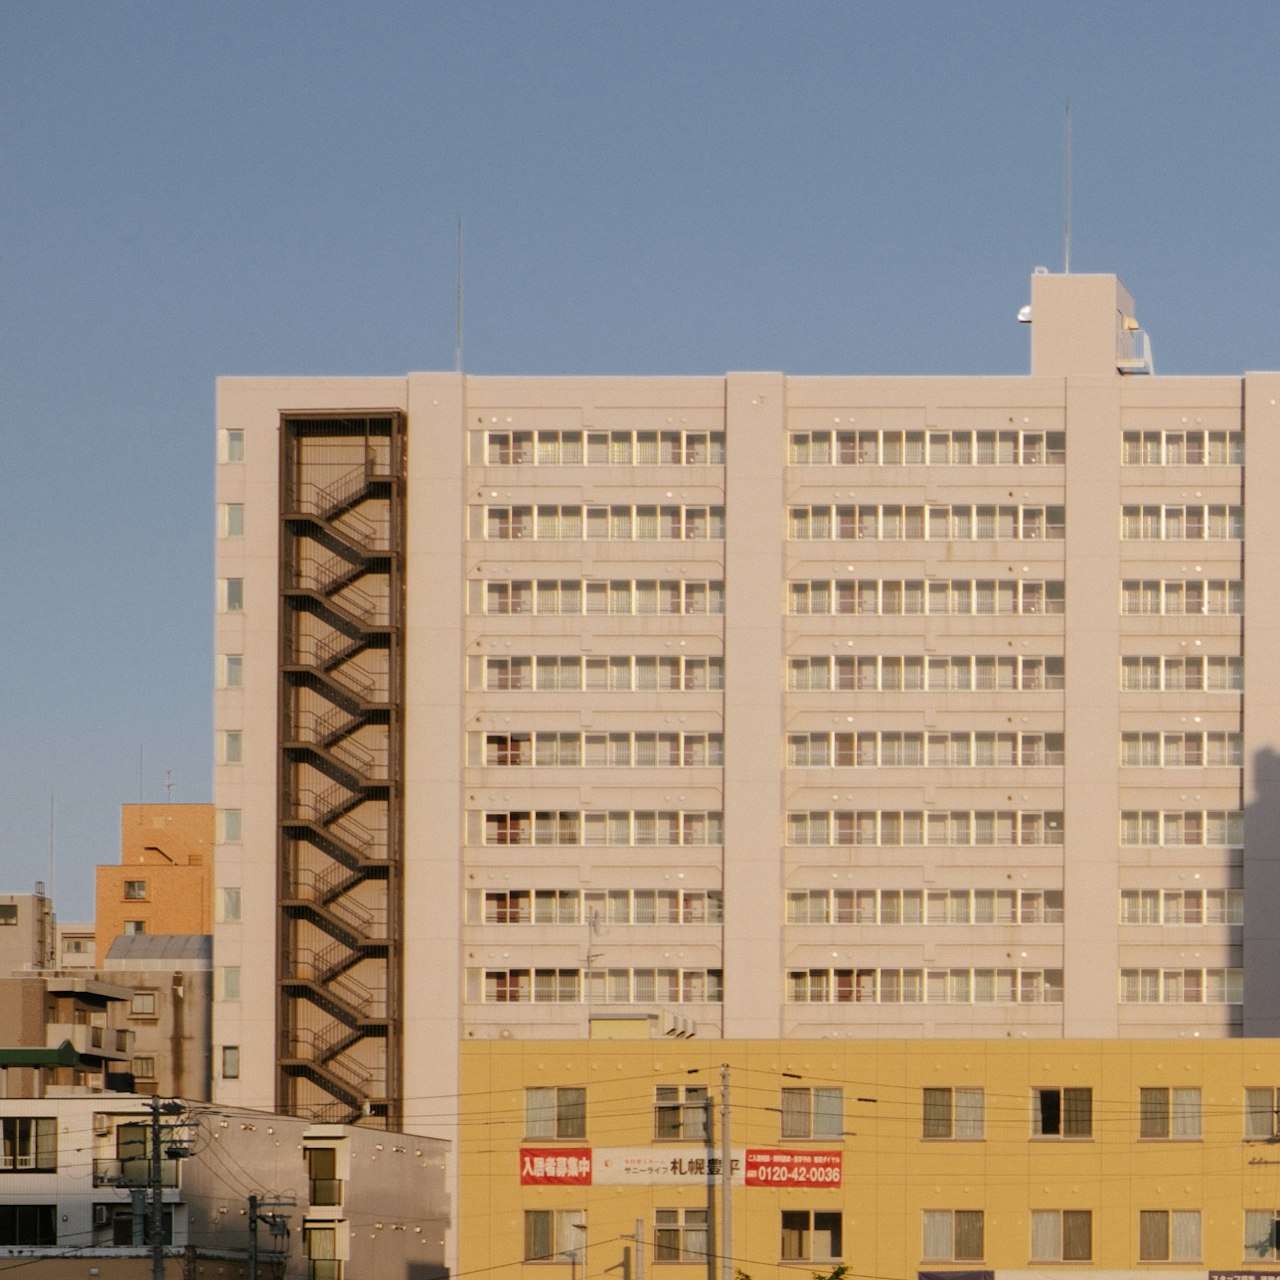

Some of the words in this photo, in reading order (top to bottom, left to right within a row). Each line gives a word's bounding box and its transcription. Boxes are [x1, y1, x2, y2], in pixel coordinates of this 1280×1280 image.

[522, 1156, 591, 1177] 入居者募集中
[758, 1166, 841, 1182] 0120-42-0036
